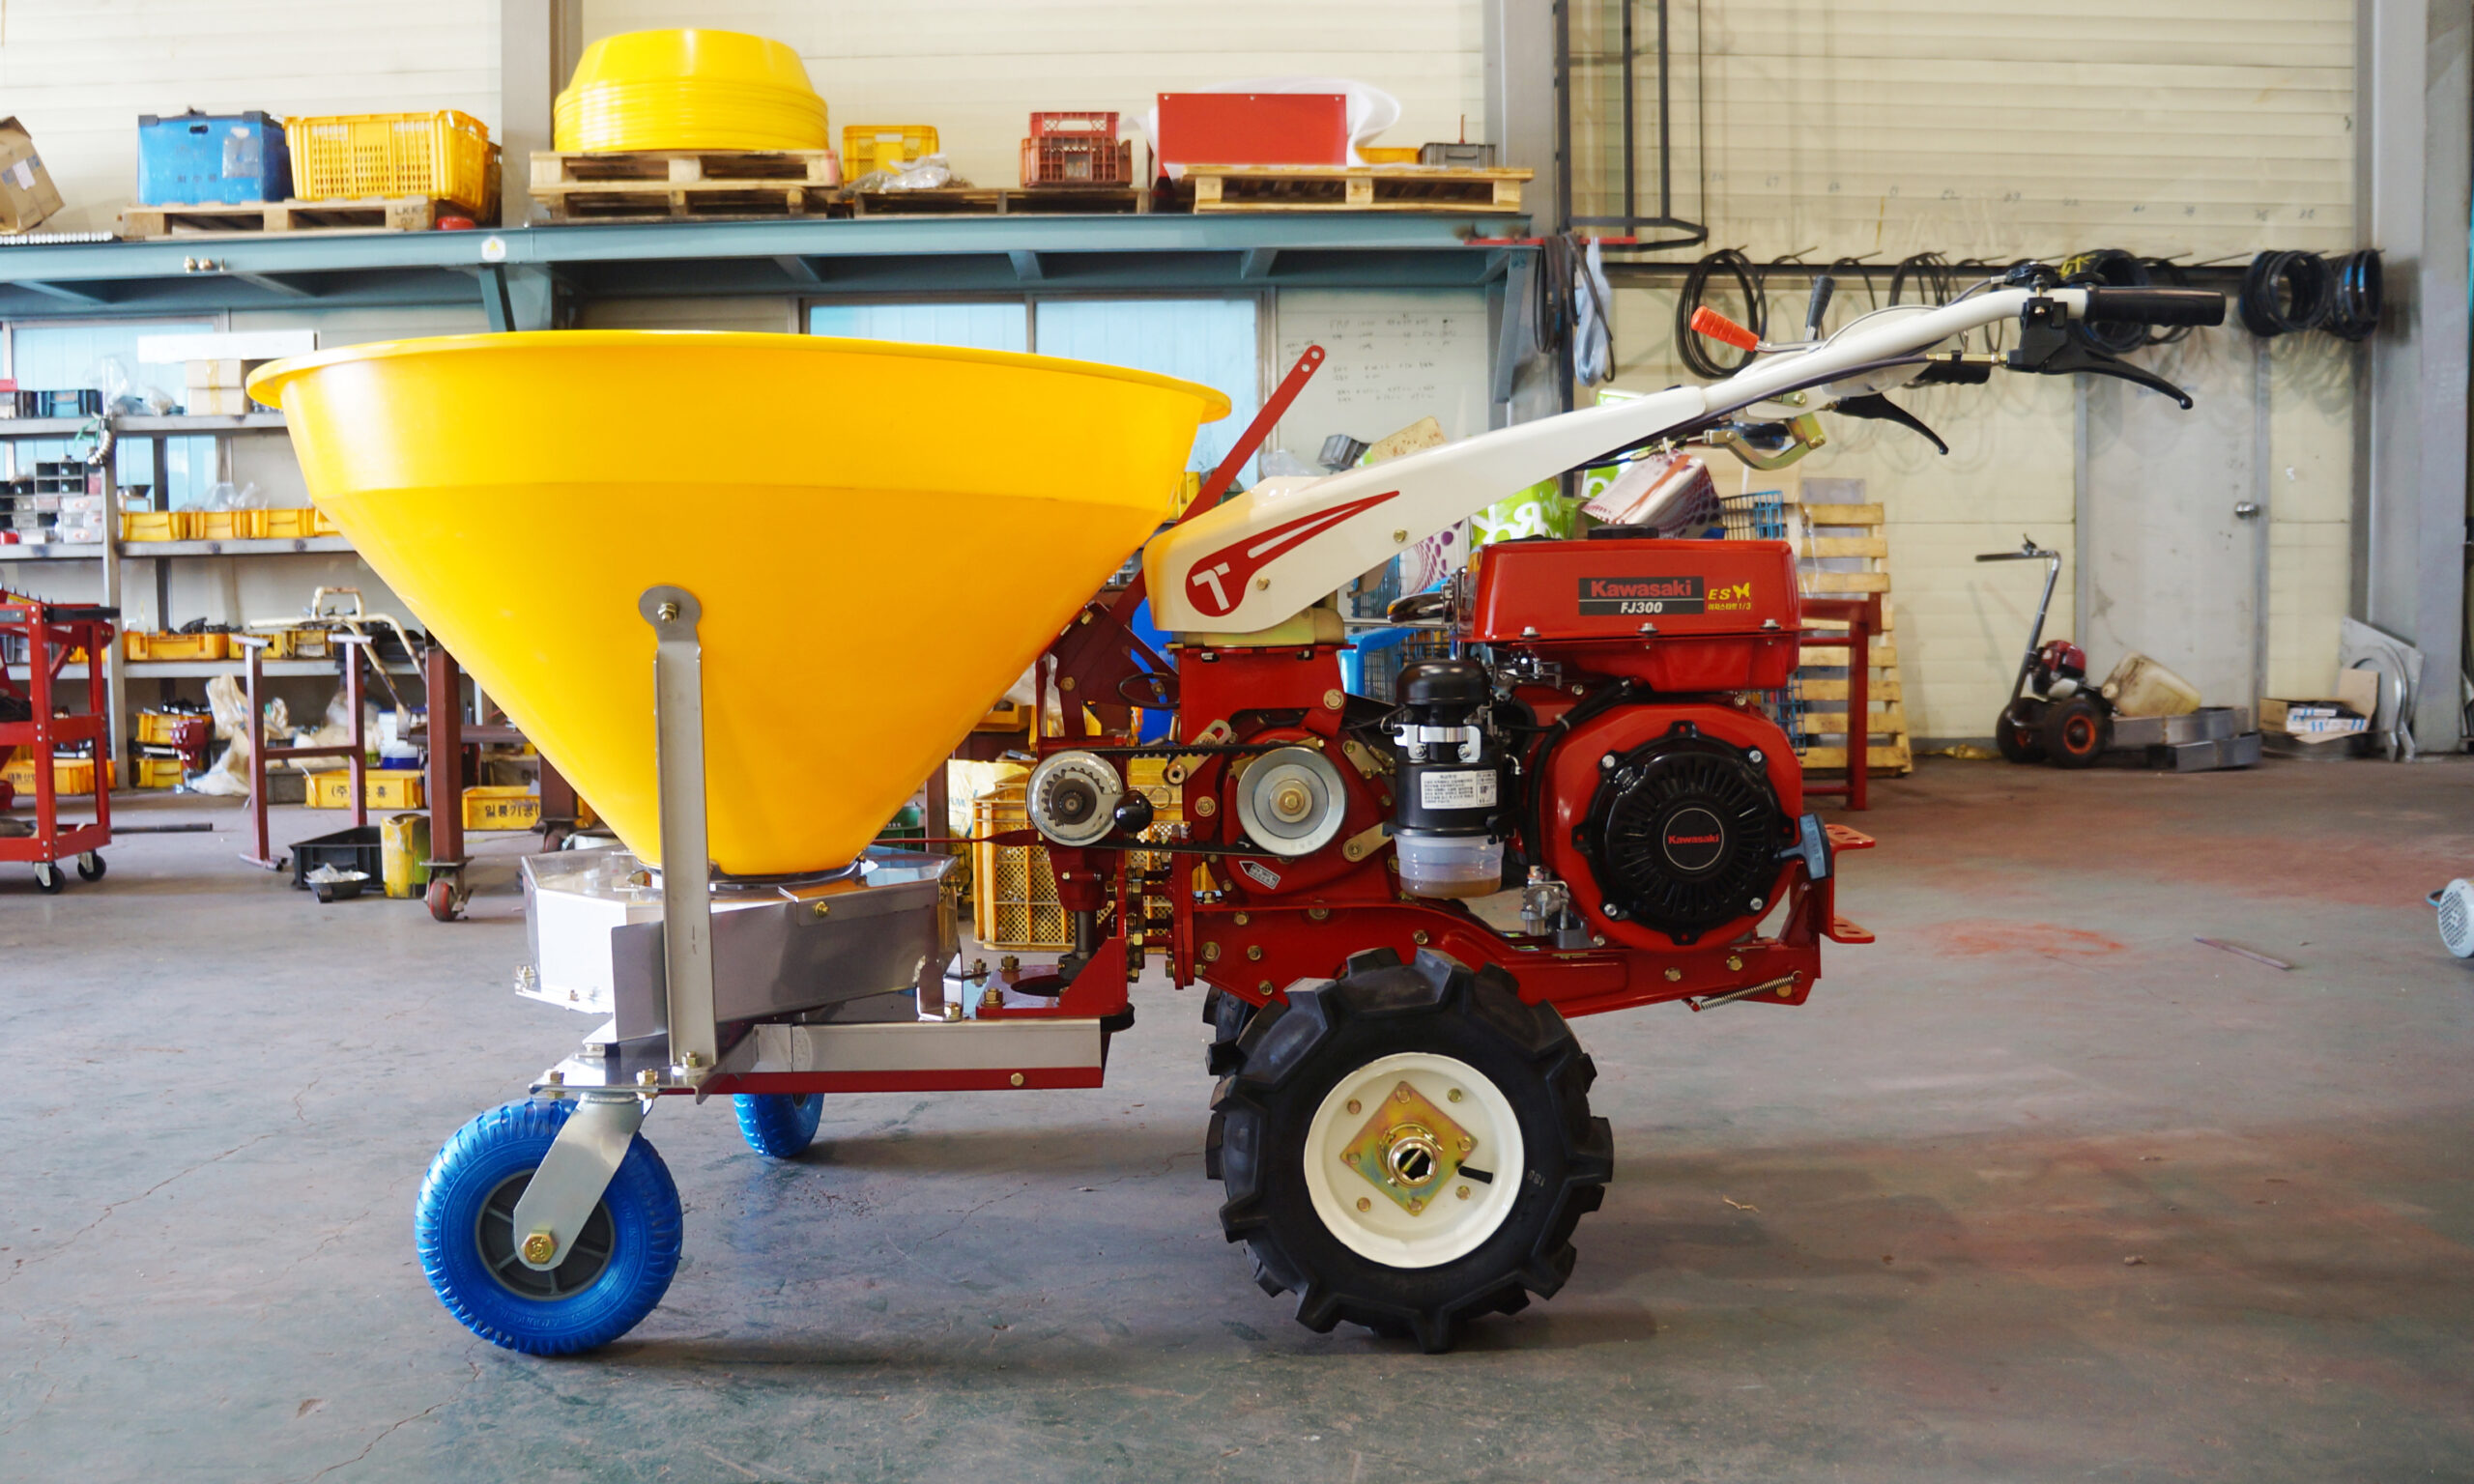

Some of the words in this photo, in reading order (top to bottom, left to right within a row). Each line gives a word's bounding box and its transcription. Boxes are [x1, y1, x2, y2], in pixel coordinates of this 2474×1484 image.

[1591, 580, 1691, 597] Kawasaki
[1708, 588, 1732, 600] ES
[1620, 602, 1663, 614] FJ300
[1668, 834, 1719, 845] Kawasaki
